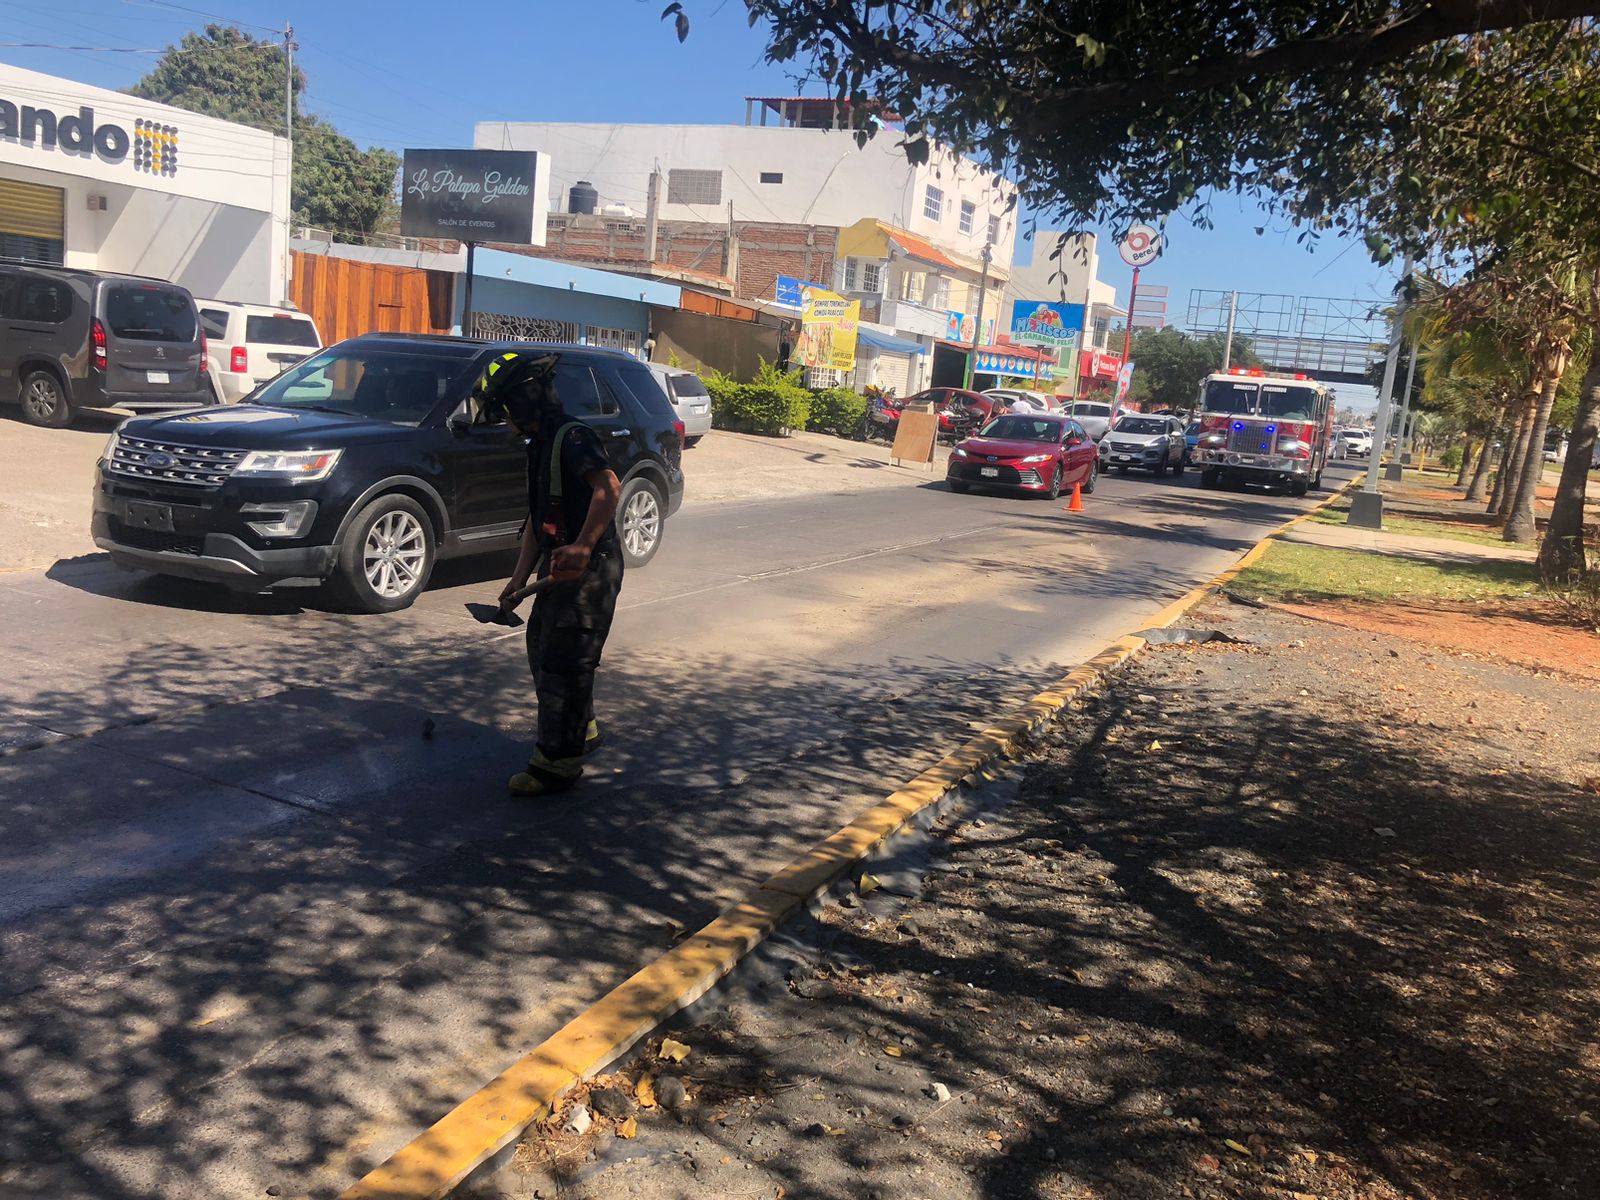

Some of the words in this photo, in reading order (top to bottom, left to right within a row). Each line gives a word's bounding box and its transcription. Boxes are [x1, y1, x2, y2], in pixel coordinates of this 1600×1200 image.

[407, 168, 430, 199] La
[432, 169, 481, 200] Palapa
[482, 171, 530, 203] Golden
[437, 217, 458, 226] SALÓN
[468, 220, 496, 228] EVENTOS
[1132, 246, 1155, 261] Berel
[1015, 317, 1076, 339] MARISCOS
